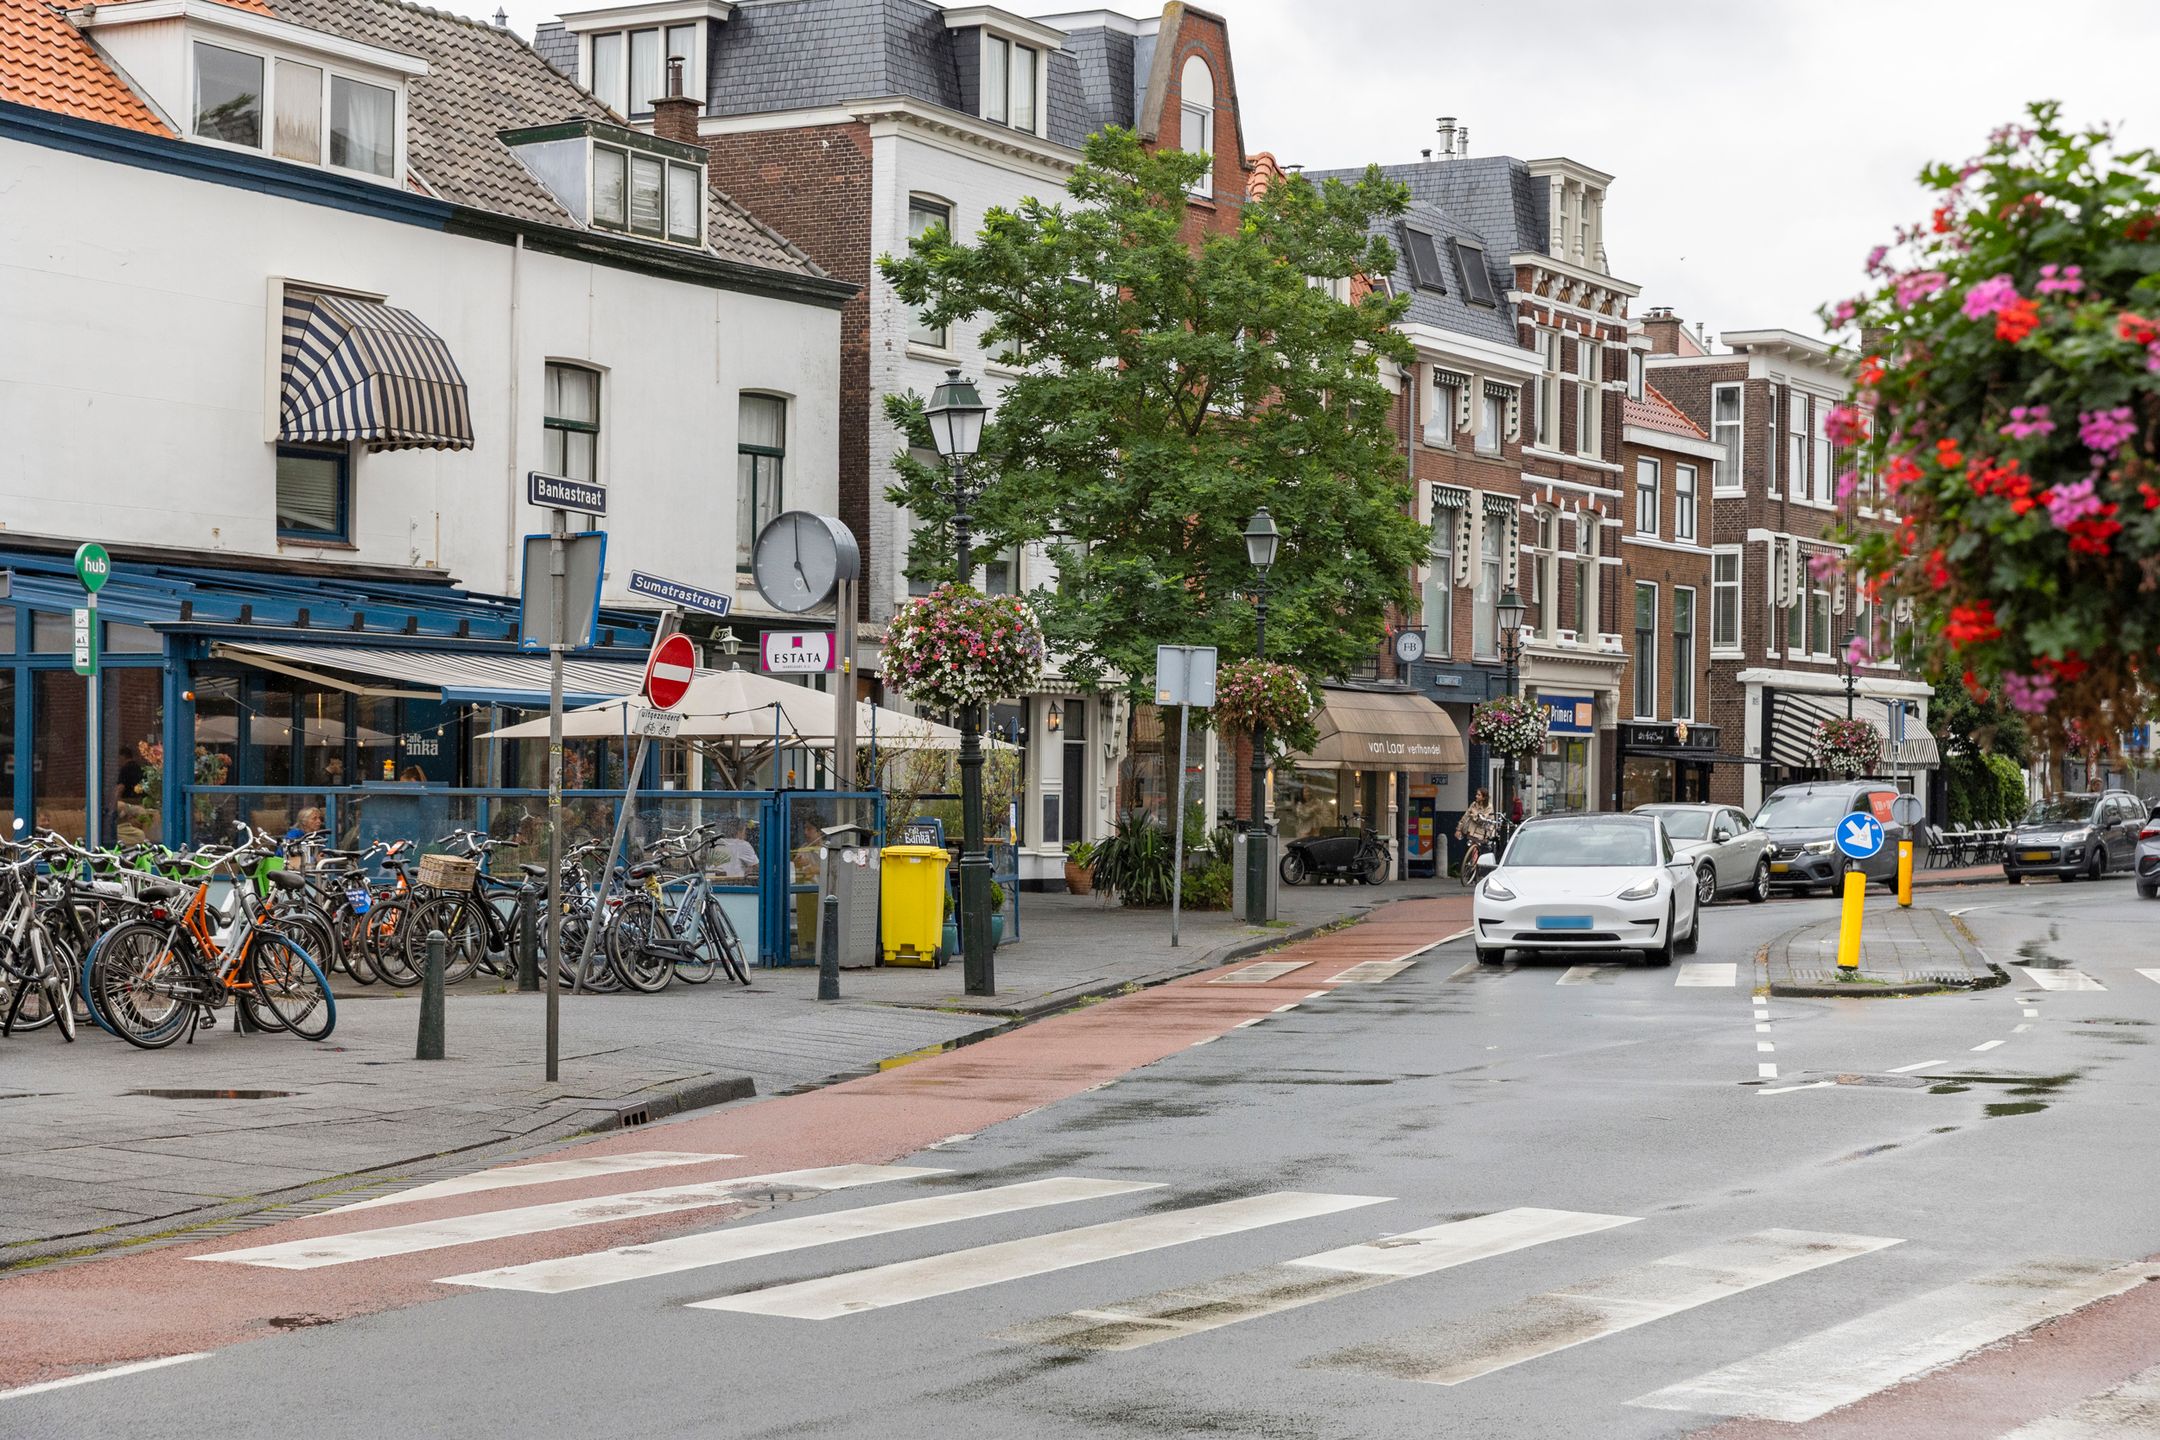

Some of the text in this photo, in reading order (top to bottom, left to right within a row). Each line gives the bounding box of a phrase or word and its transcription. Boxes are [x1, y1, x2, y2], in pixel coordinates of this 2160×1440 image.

[538, 479, 602, 506] Bankastraat
[84, 556, 106, 574] hub
[635, 576, 722, 610] Sumatrastraat
[774, 652, 821, 664] ESTATA
[641, 711, 681, 722] uitgezonderd
[1550, 704, 1573, 723] Primera
[1368, 742, 1385, 753] van
[1386, 740, 1405, 754] Laar
[904, 832, 931, 844] Banka
